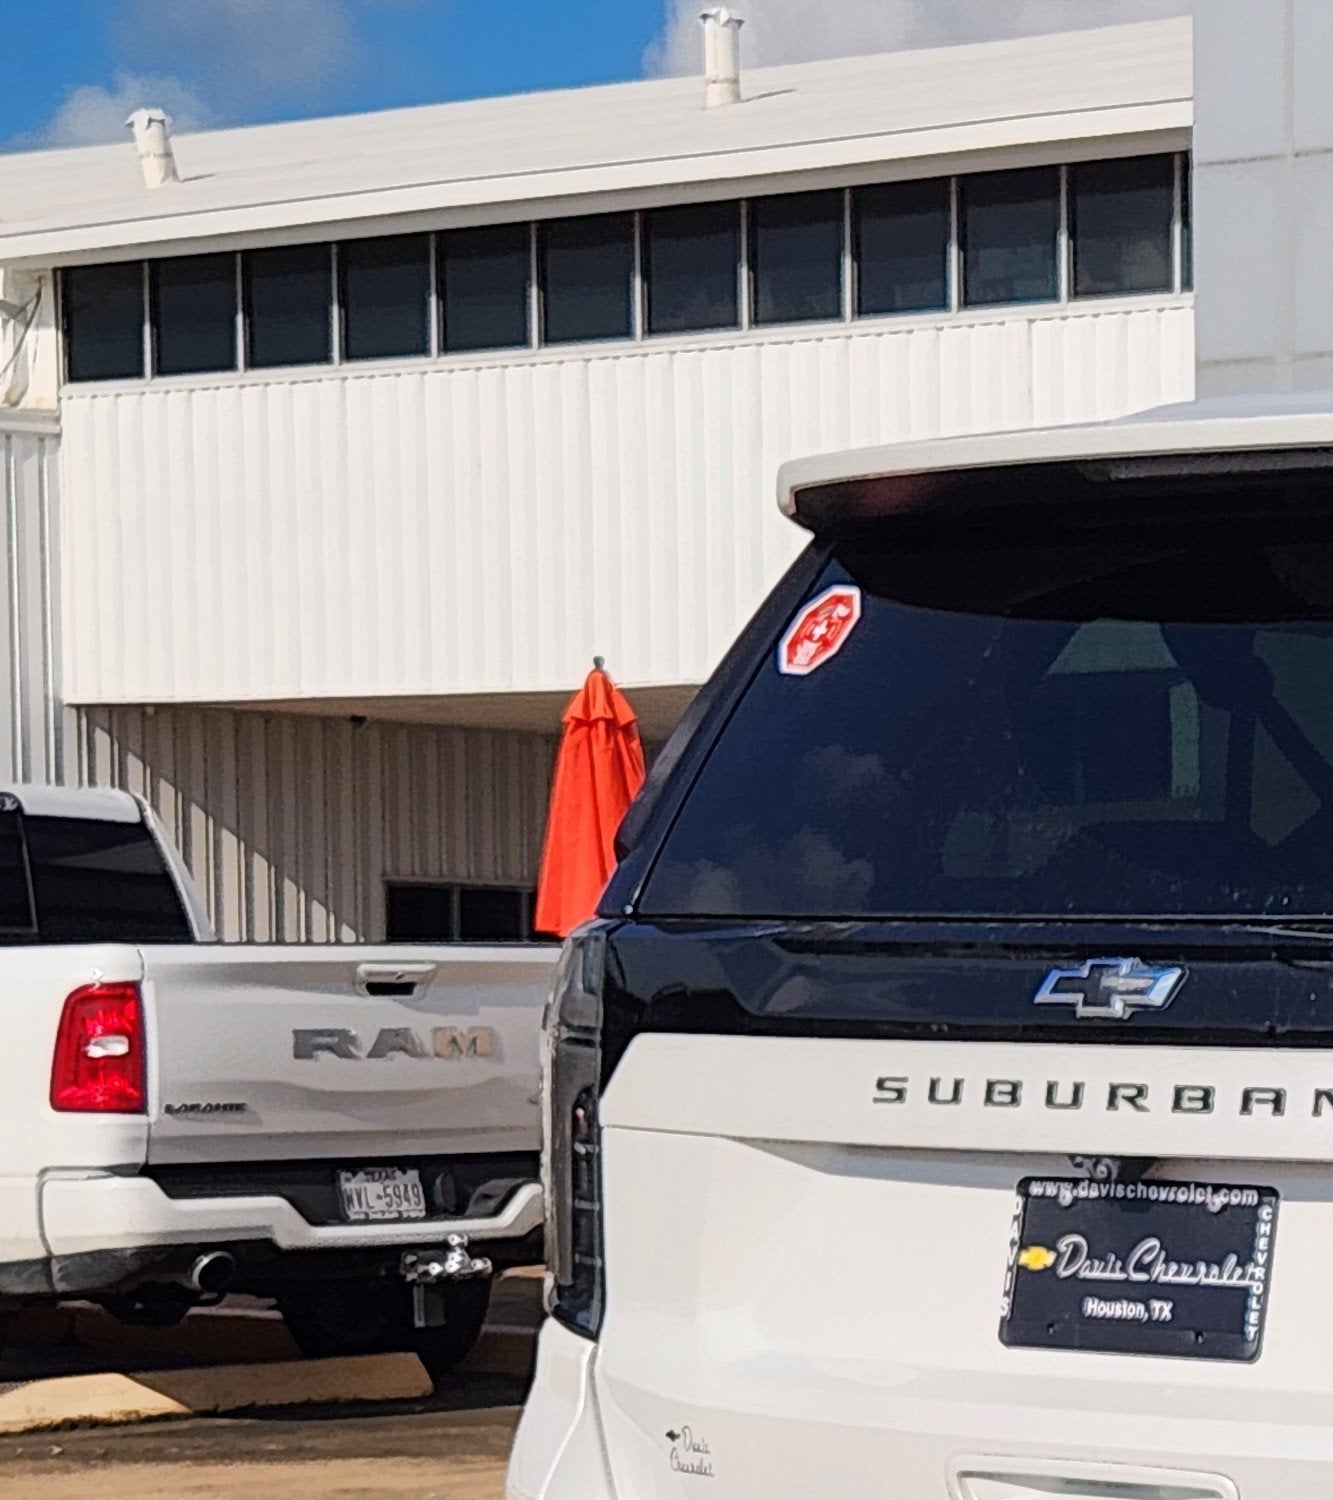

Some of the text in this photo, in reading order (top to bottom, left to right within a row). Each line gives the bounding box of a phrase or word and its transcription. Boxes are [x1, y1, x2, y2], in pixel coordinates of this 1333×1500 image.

[292, 1026, 495, 1061] RAM
[1055, 1233, 1128, 1280] Davis
[1244, 1204, 1273, 1342] CHEVROLET
[1082, 1296, 1174, 1323] Houston, TX
